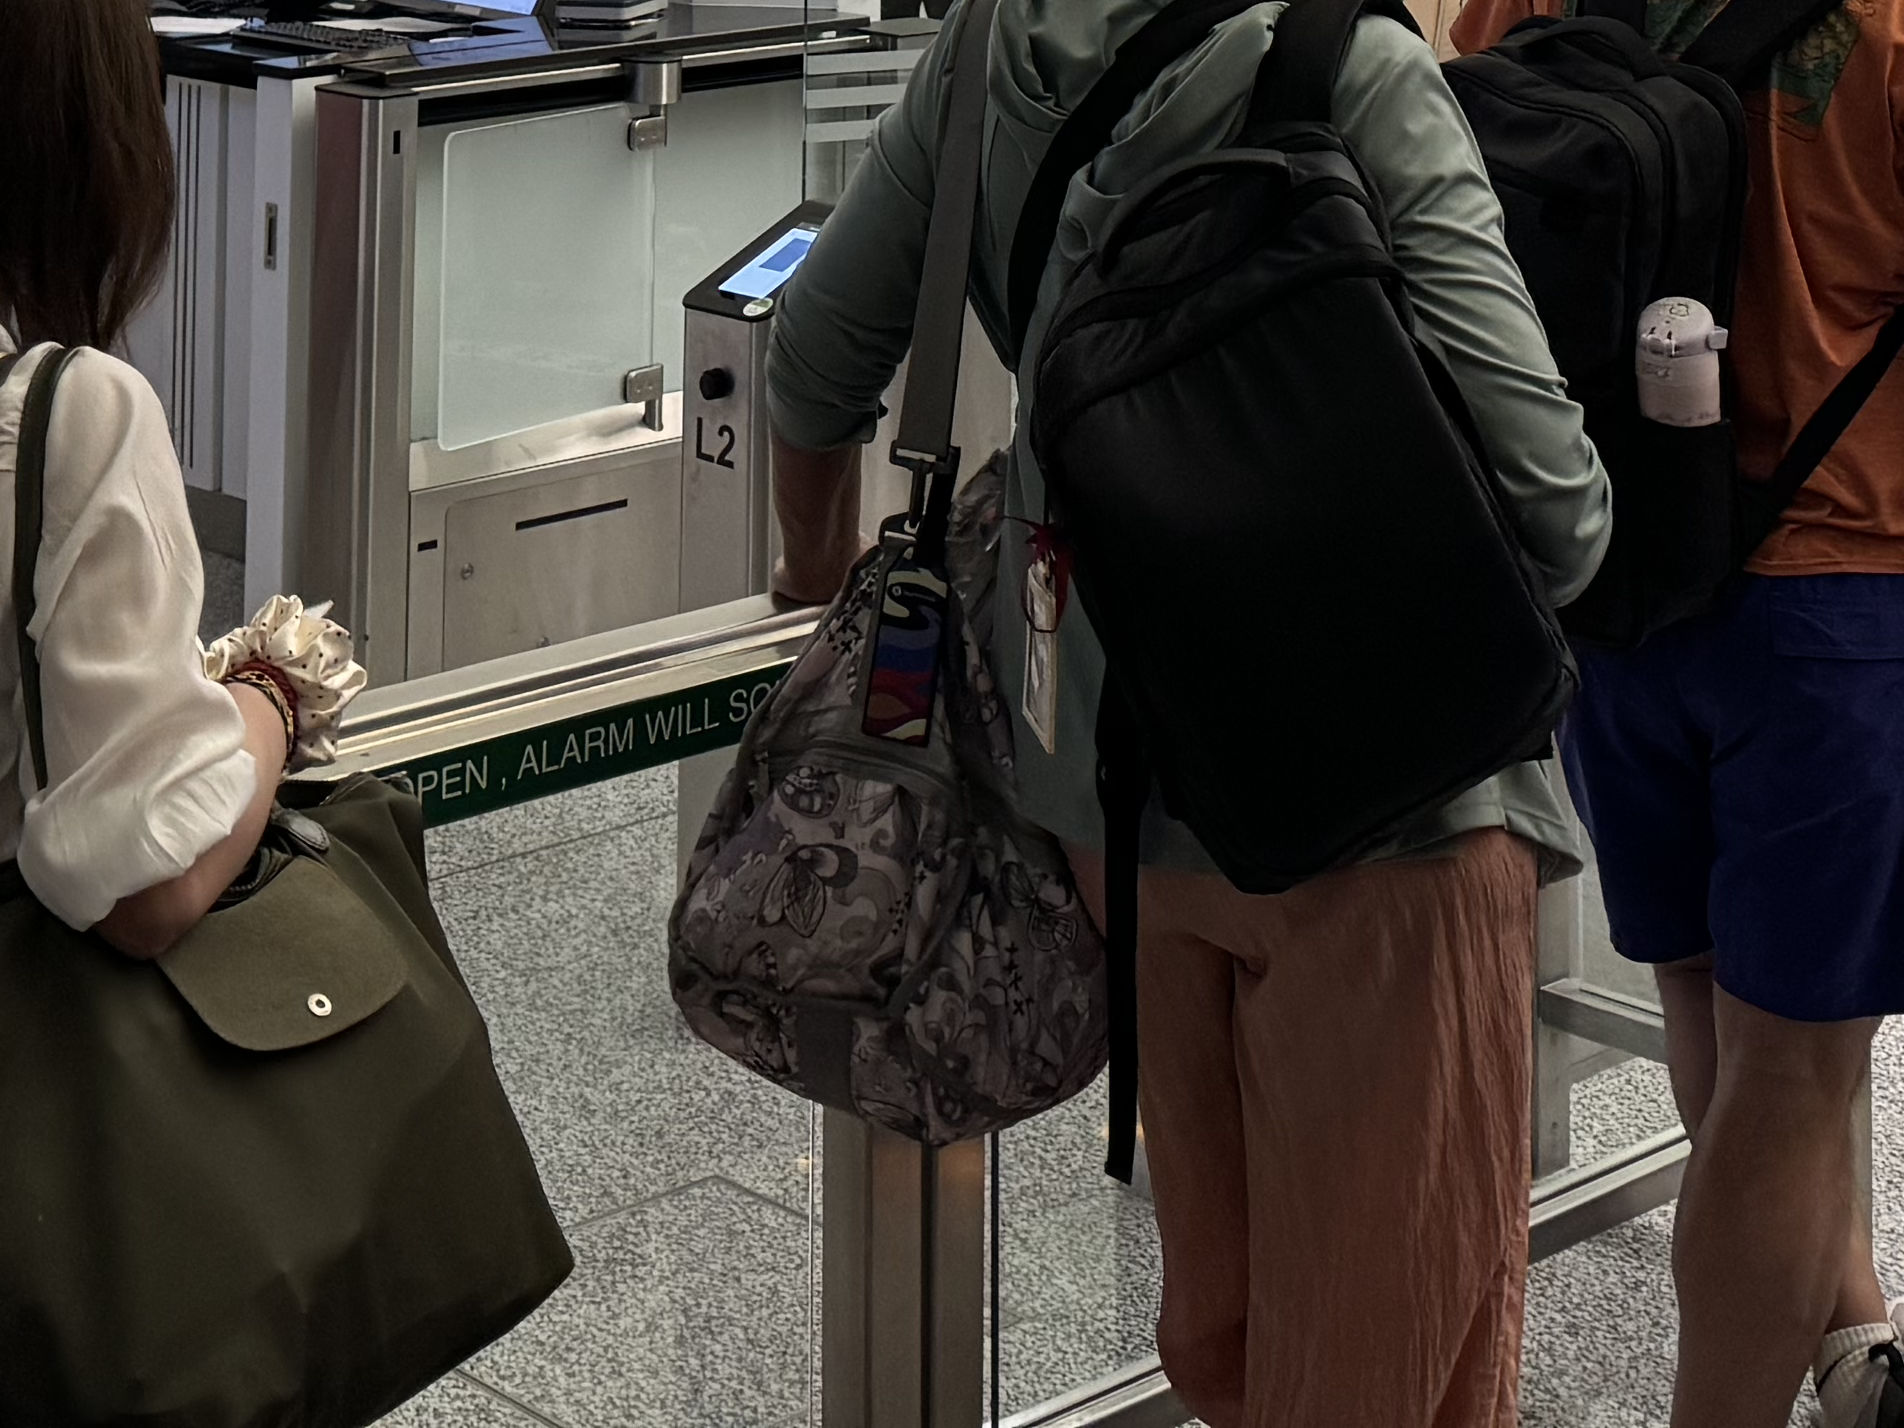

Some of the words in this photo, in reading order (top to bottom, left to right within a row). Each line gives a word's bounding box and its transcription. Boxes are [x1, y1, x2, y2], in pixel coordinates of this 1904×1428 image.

[695, 416, 736, 469] L2
[516, 717, 634, 780] ALARM
[645, 697, 721, 745] WILL
